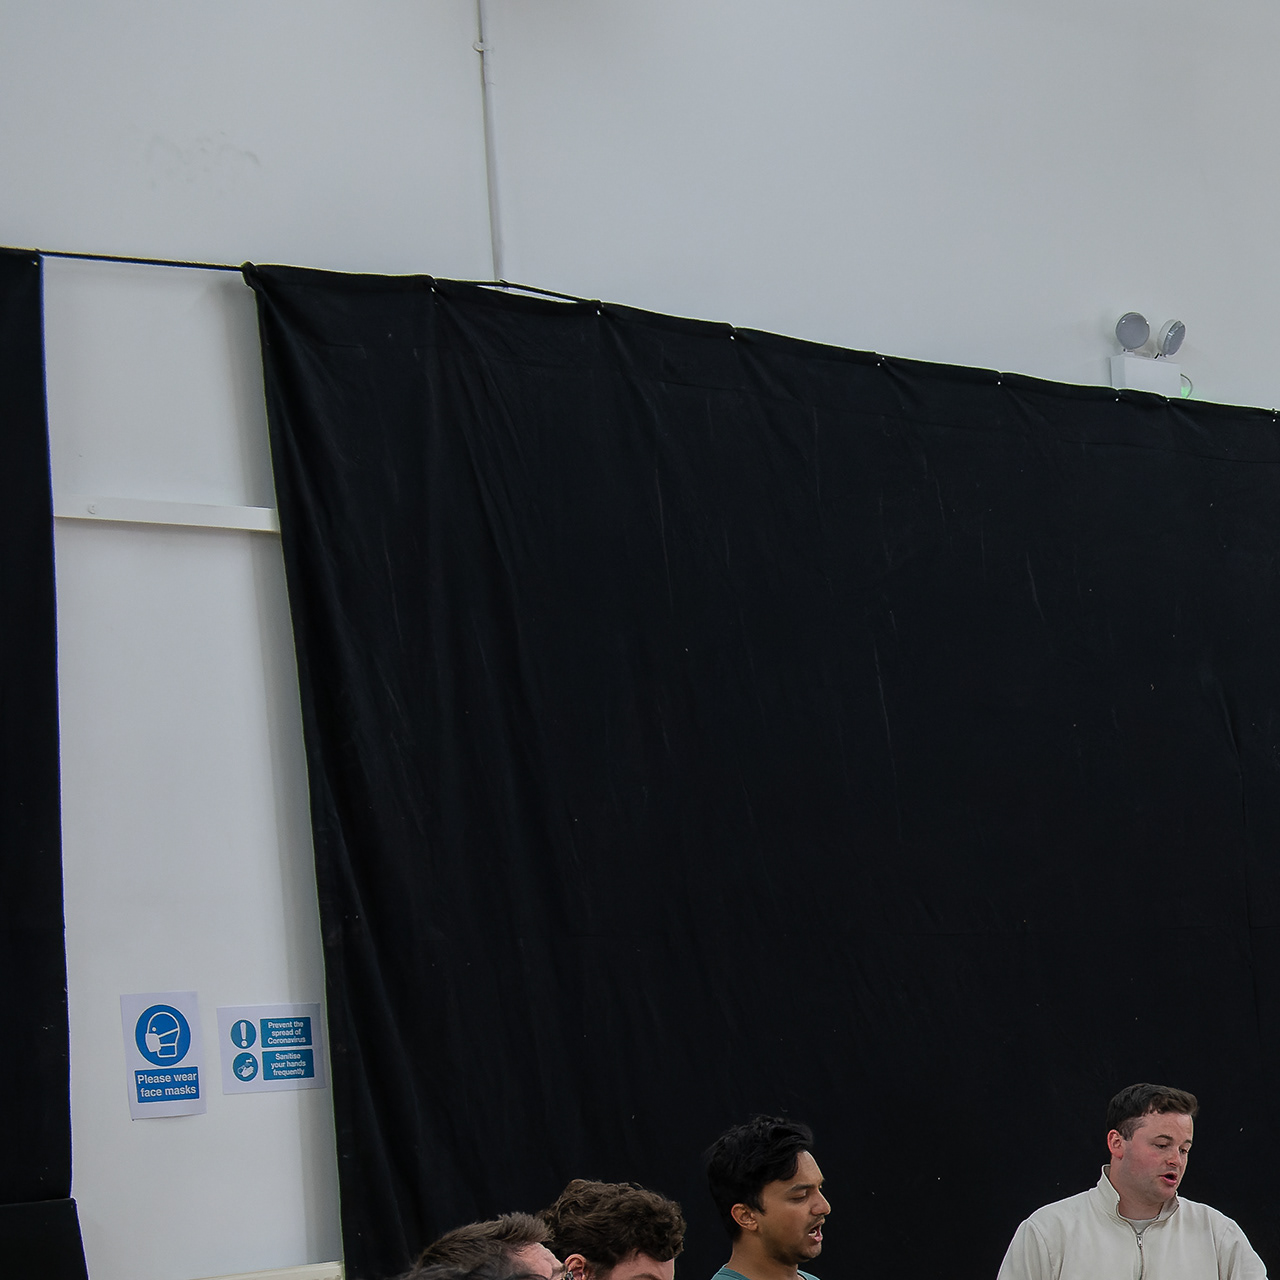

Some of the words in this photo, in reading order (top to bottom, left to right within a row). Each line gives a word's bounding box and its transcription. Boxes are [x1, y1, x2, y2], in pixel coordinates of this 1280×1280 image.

[293, 1020, 304, 1028] the
[271, 1029, 294, 1037] spread
[267, 1036, 306, 1044] Coronavirus
[272, 1068, 305, 1076] frequently
[137, 1074, 171, 1084] Please
[173, 1073, 197, 1082] wear
[140, 1087, 162, 1097] face
[164, 1085, 197, 1095] masks
